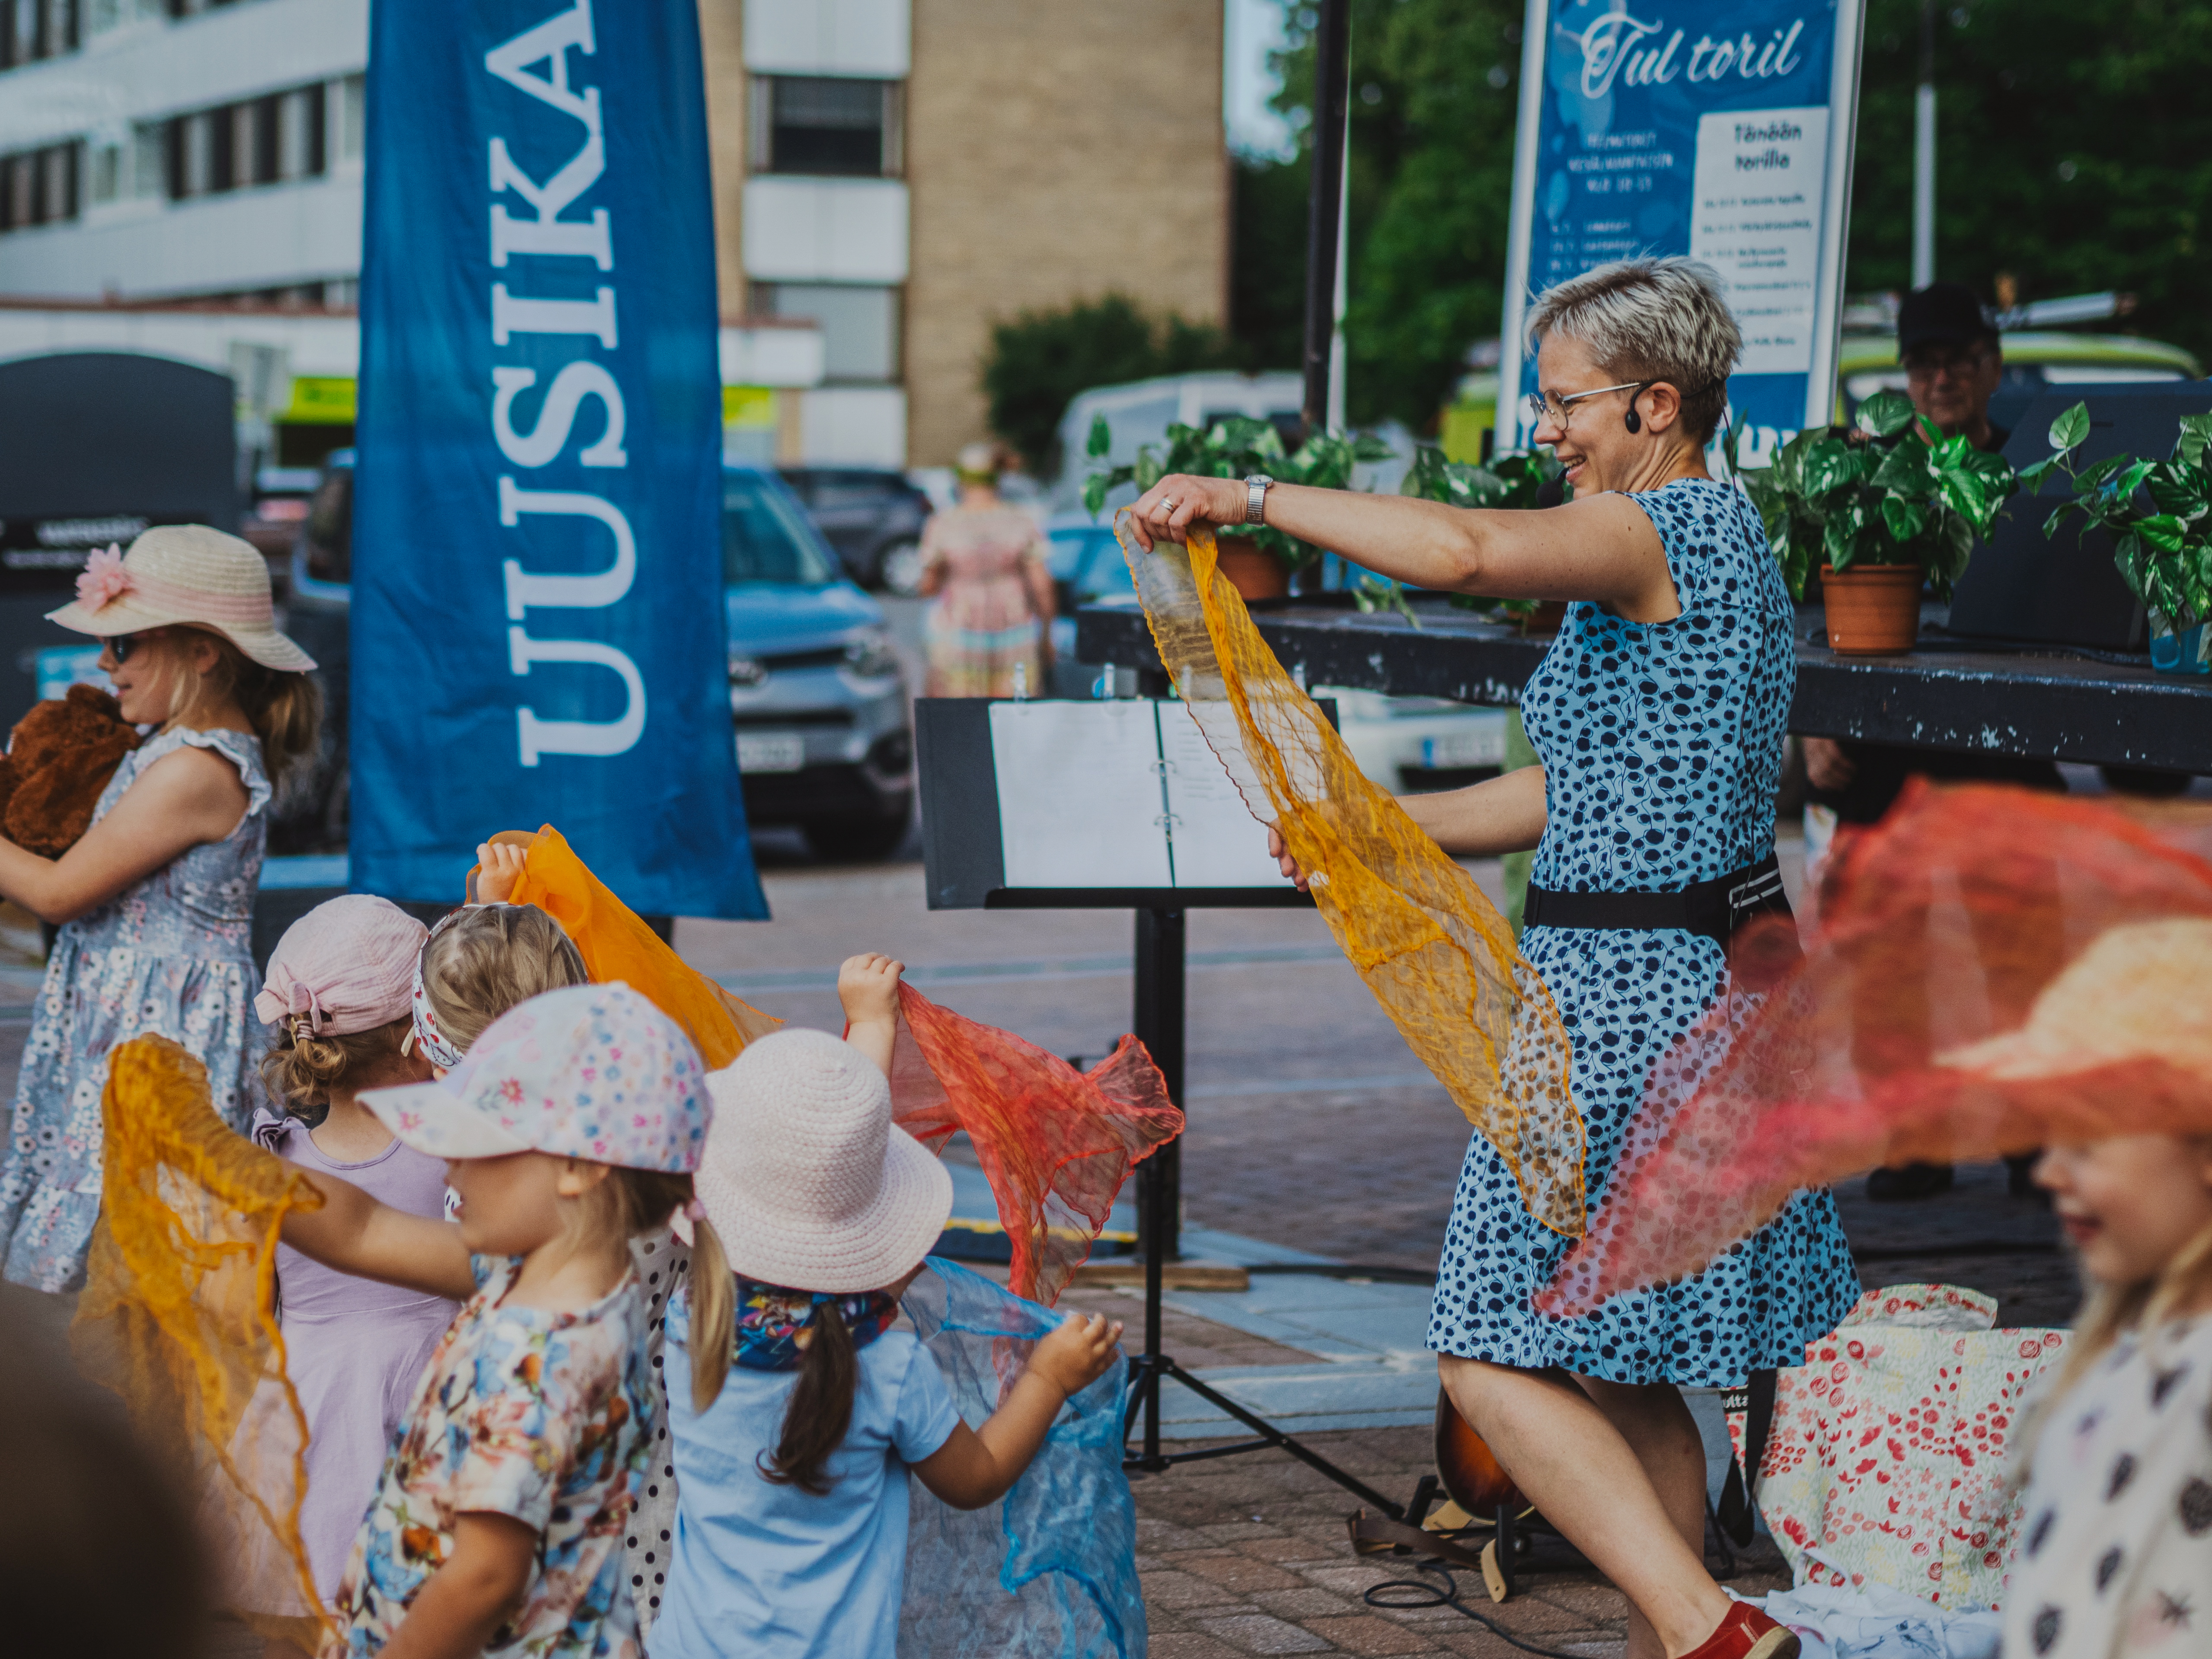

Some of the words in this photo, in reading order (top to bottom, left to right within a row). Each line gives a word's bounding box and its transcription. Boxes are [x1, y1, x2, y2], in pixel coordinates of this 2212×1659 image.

[1734, 120, 1802, 144] Tänään
[1735, 149, 1791, 171] torilla
[484, 0, 647, 768] UUSIKA
